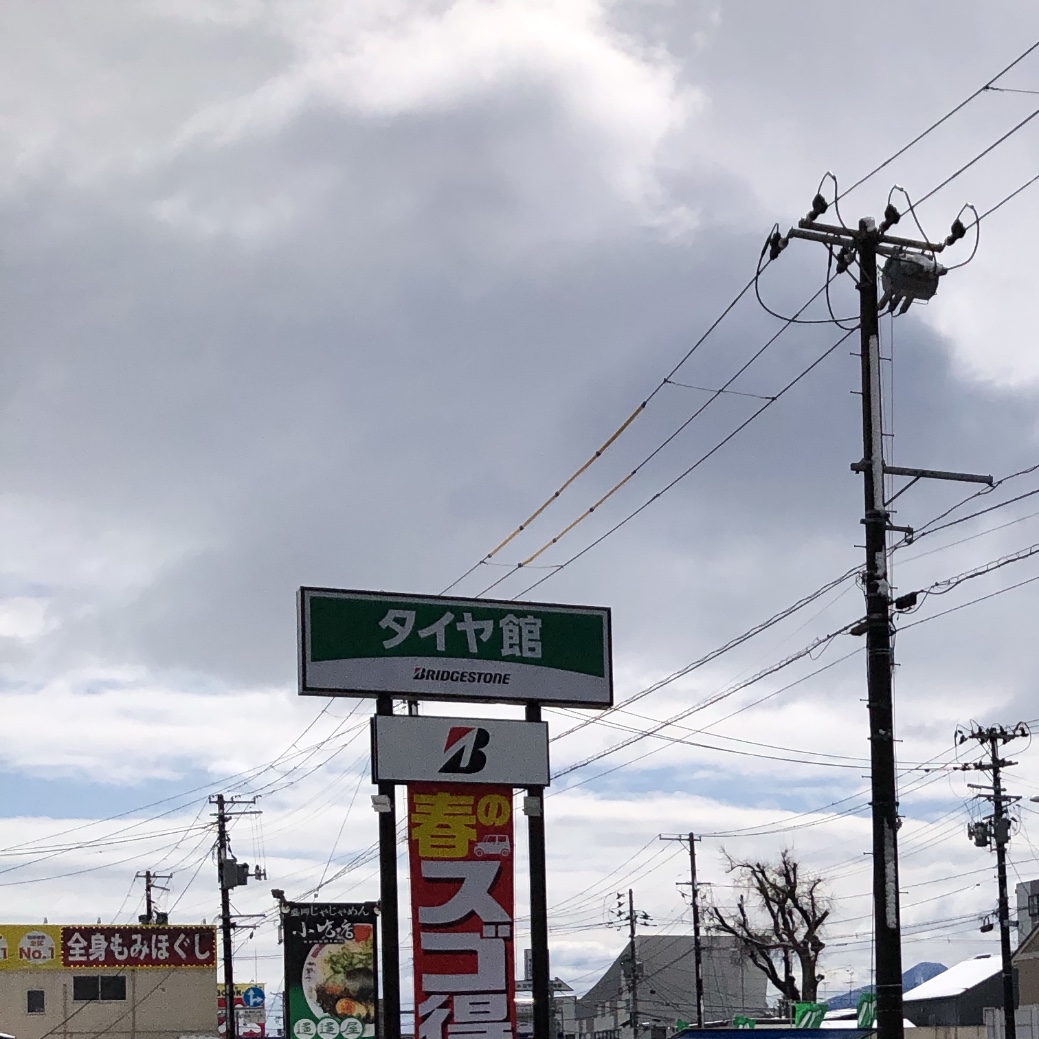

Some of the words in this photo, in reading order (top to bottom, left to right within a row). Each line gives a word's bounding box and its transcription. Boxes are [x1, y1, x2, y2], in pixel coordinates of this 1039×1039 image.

[378, 609, 542, 658] タイヤ館
[413, 667, 511, 685] BRIDGESTONE
[411, 792, 511, 858] 春の
[19, 947, 55, 960] No.1
[66, 932, 211, 962] 全身もみほぐし
